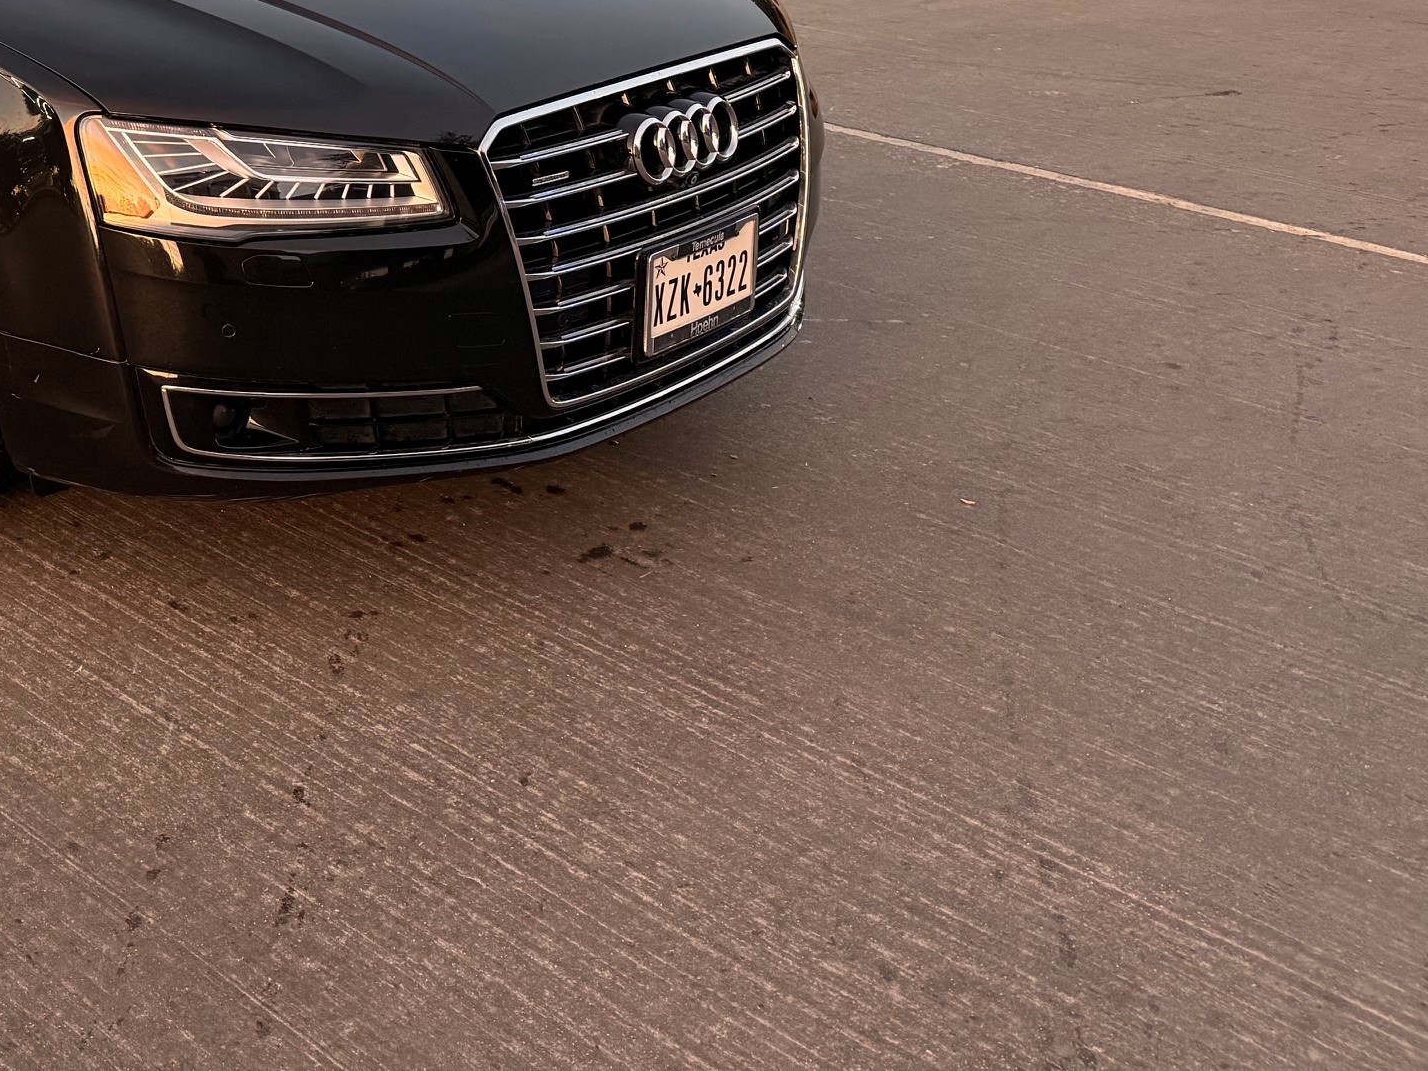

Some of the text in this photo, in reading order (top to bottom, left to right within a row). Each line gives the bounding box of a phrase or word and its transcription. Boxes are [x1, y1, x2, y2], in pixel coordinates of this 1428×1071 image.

[653, 249, 748, 328] XZK 6322
[690, 315, 719, 337] Hoehn
